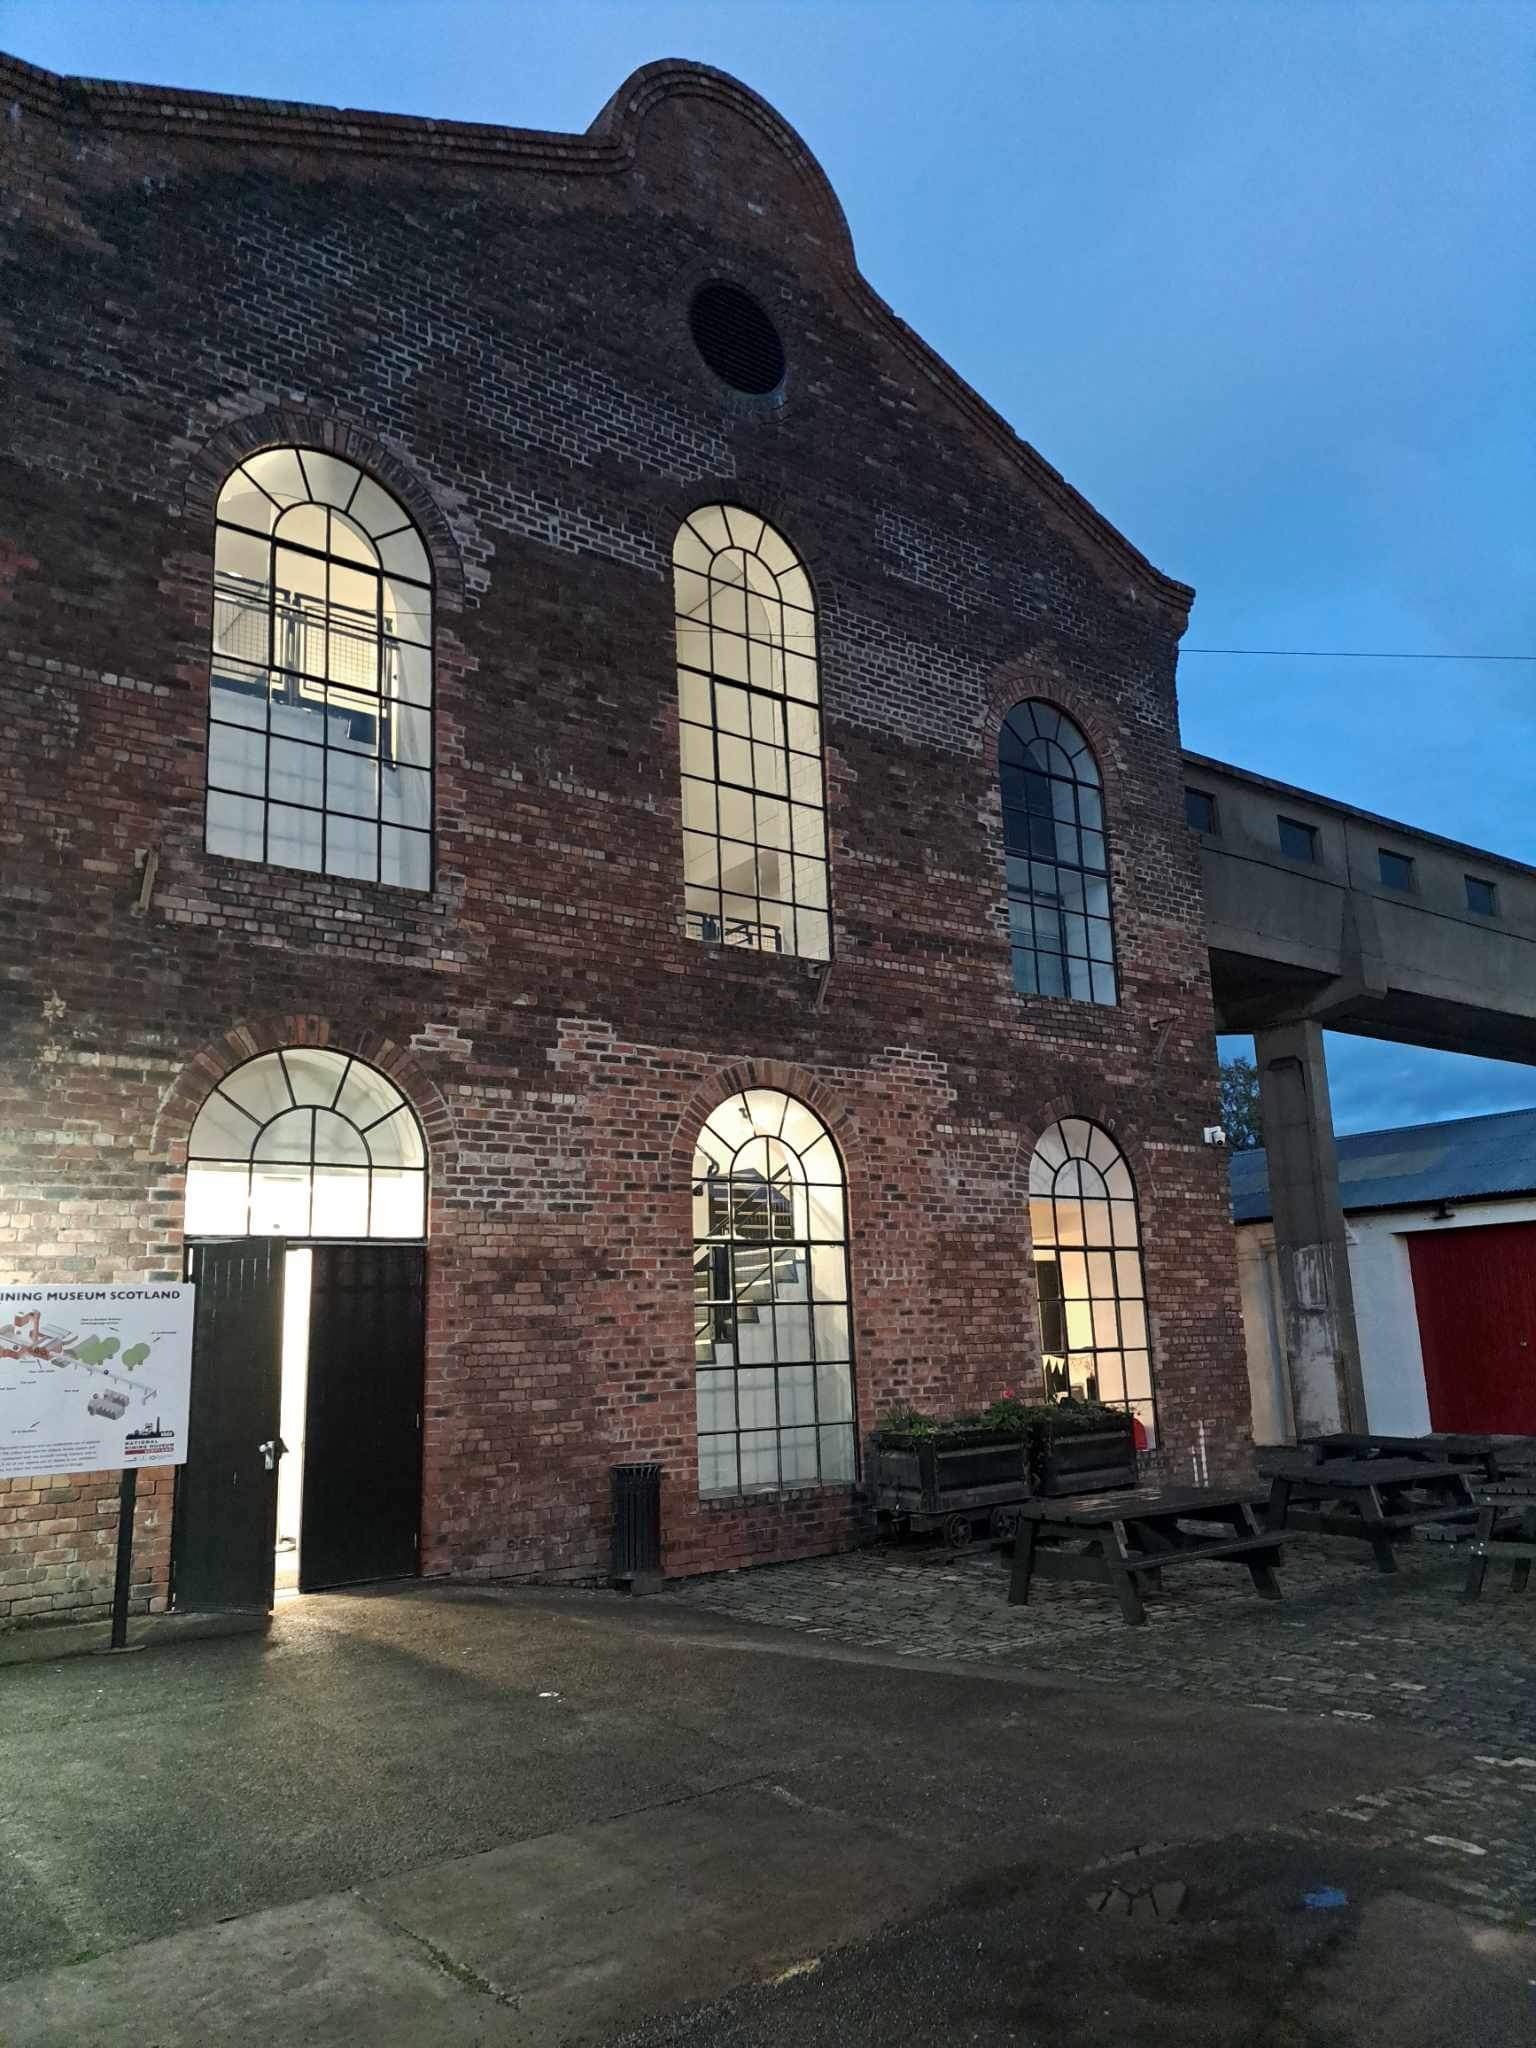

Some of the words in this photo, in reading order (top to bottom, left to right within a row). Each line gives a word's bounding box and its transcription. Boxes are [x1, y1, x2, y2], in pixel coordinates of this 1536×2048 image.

[0, 1291, 43, 1301] INING
[46, 1291, 106, 1301] MUSEUM
[110, 1290, 181, 1300] SCOTLAND
